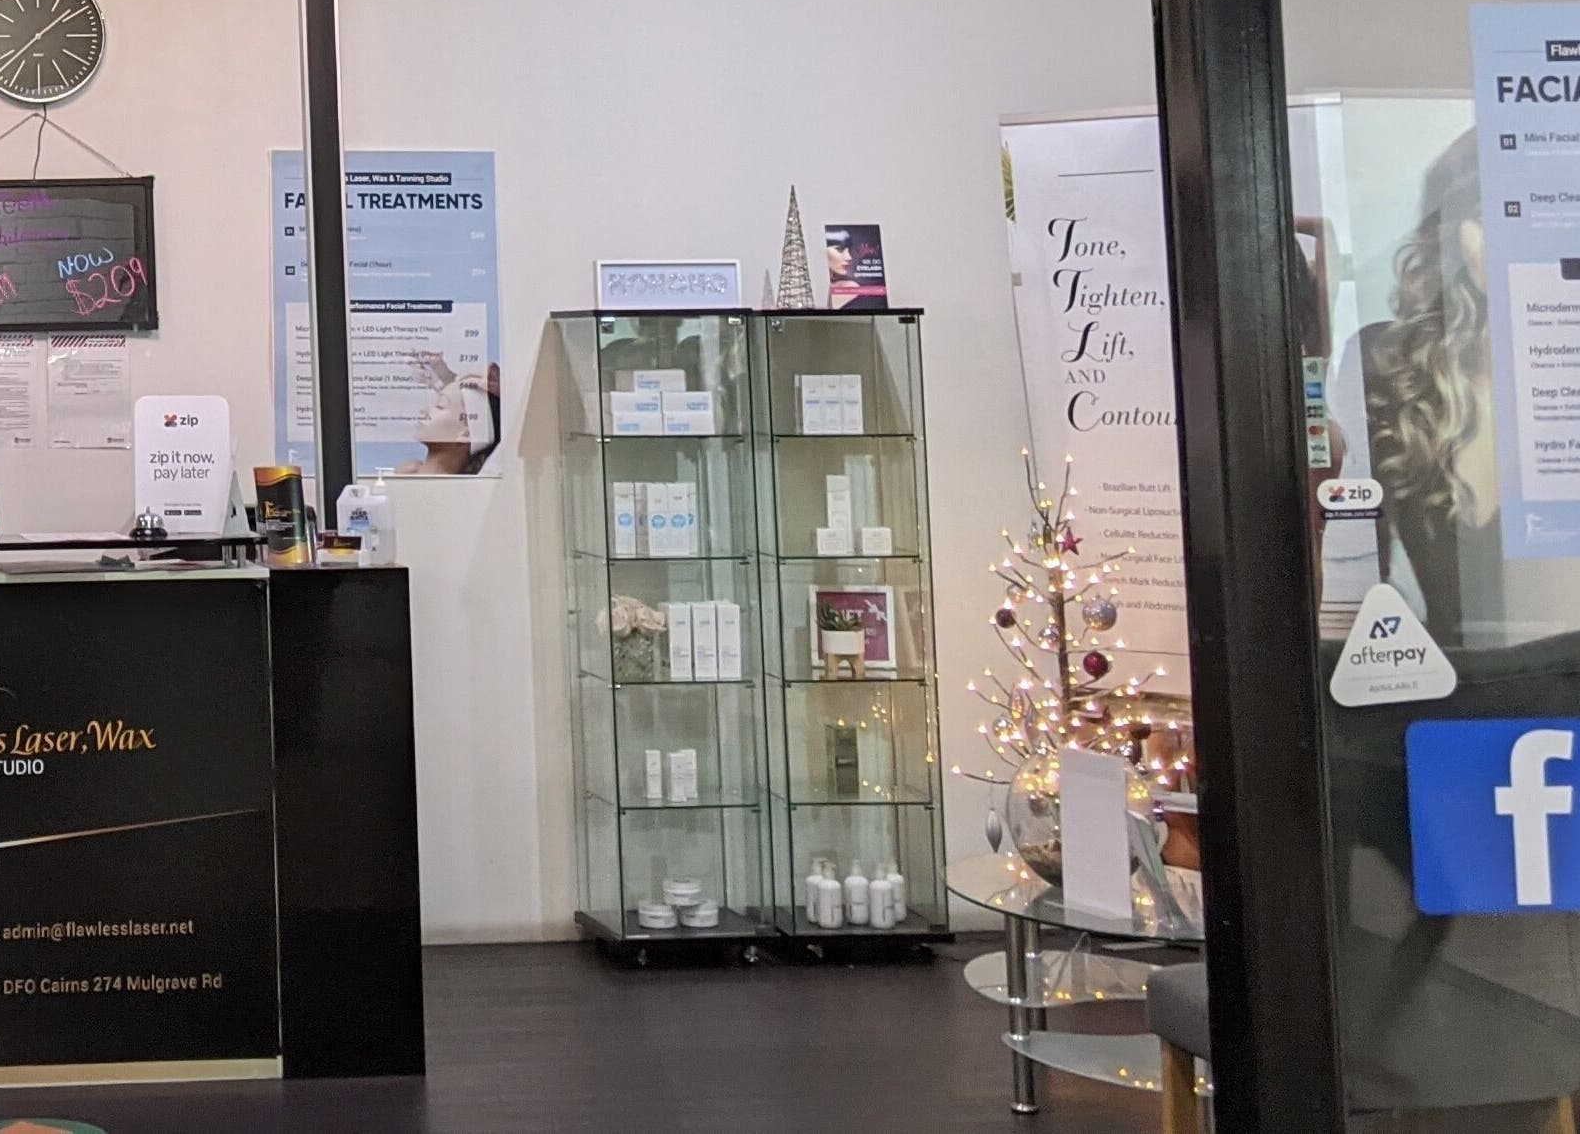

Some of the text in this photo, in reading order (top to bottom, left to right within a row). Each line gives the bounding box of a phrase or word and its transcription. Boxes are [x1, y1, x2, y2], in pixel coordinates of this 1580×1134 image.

[1524, 133, 1547, 142] Mini
[372, 174, 388, 183] Wax
[396, 174, 425, 184] Tanning
[426, 174, 449, 183] Studio
[357, 193, 484, 210] TREATMENTS
[1530, 192, 1556, 204] Deep
[1048, 217, 1126, 262] Tone,
[58, 247, 114, 279] NOW
[66, 257, 148, 316] $209
[406, 302, 442, 310] Treatments
[1061, 321, 1135, 364] Lift,
[1065, 370, 1107, 384] AND
[1532, 387, 1558, 399] Deep
[1068, 390, 1178, 432] Contou
[180, 414, 198, 427] zip
[1535, 440, 1566, 452] Hydro
[149, 451, 181, 466] zip it
[154, 467, 211, 482] pay later
[1103, 483, 1170, 492] Brazilian Butt Lift
[1348, 485, 1372, 502] zip
[1089, 506, 1141, 516] Non-Surgical
[1104, 530, 1179, 539] Cellulite Reduction
[1129, 577, 1151, 587] Mark
[1350, 644, 1427, 667] afterpay
[2, 919, 194, 942] admin@flawlesslaser.net
[3, 973, 223, 995] DFO Cairns 274 Mulgrave Rd
